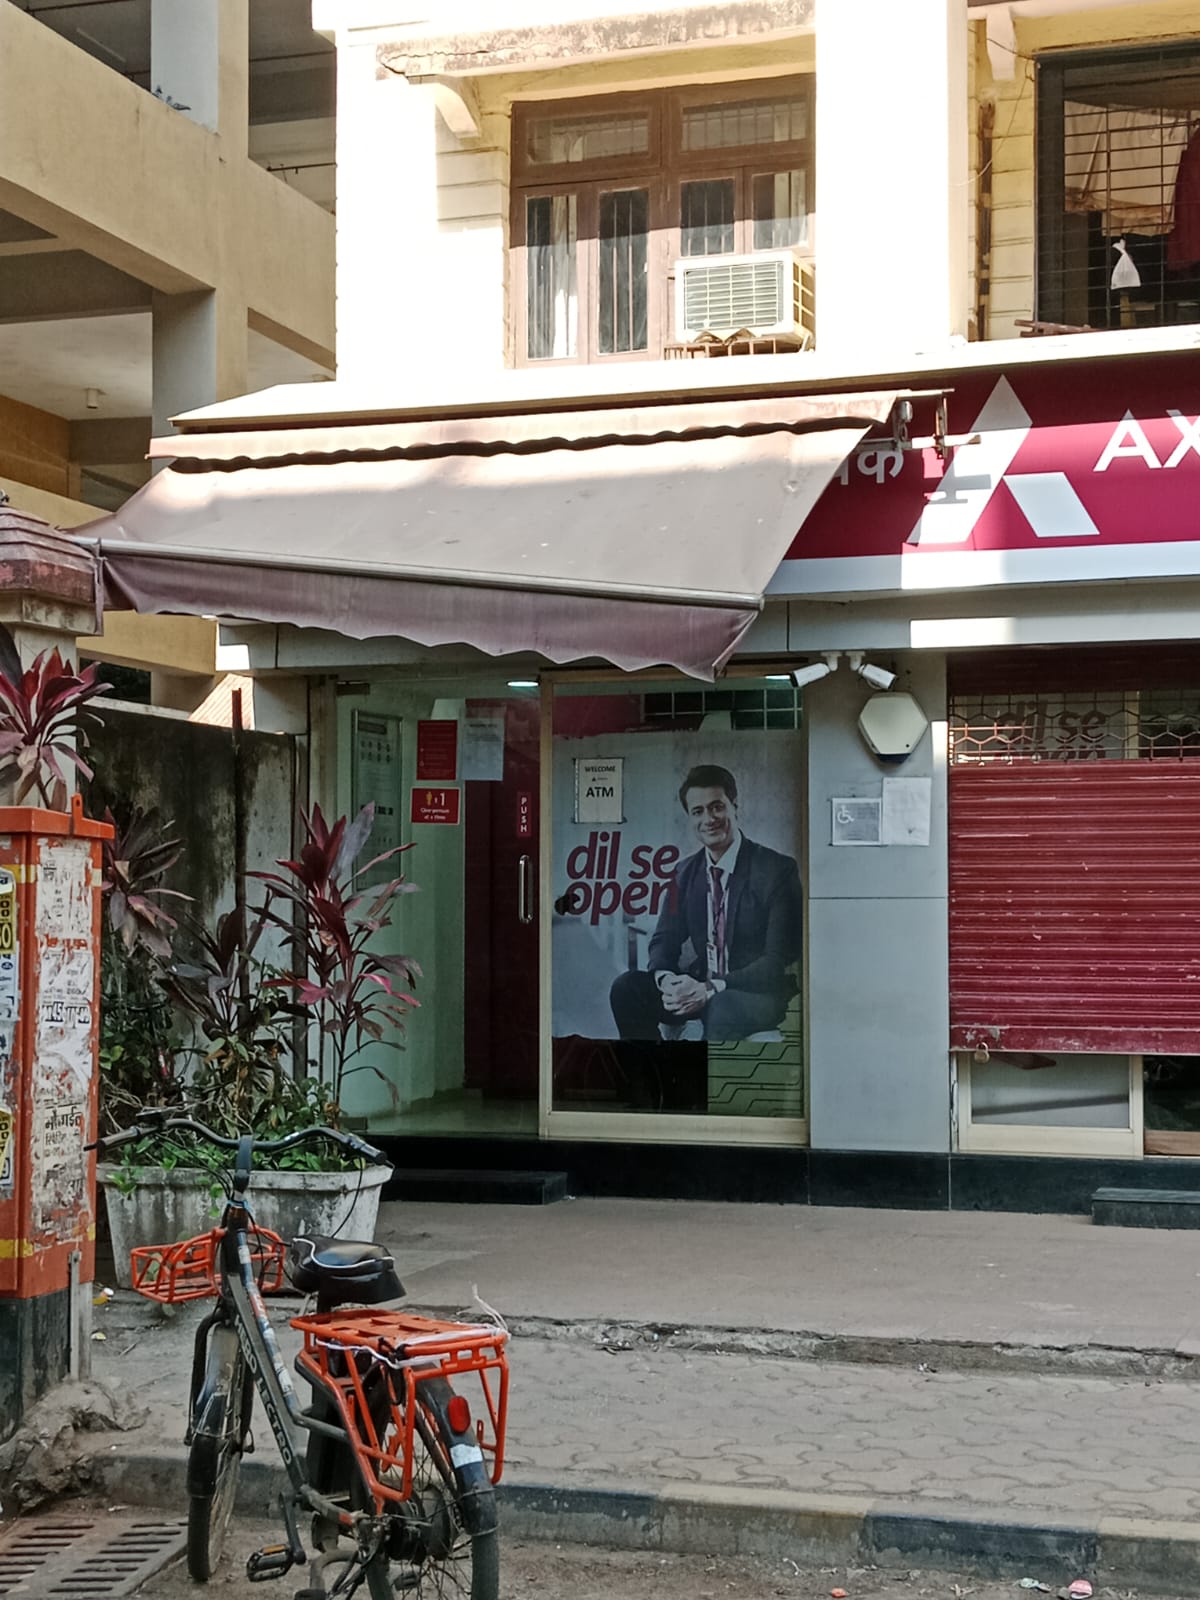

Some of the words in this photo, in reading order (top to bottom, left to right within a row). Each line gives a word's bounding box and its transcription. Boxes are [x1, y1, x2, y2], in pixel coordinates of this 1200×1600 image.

[584, 765, 616, 773] WELCOME
[586, 786, 614, 798] ATM
[520, 796, 528, 833] PUSH
[566, 831, 621, 880] dil
[628, 845, 680, 880] se
[566, 880, 679, 926] open
